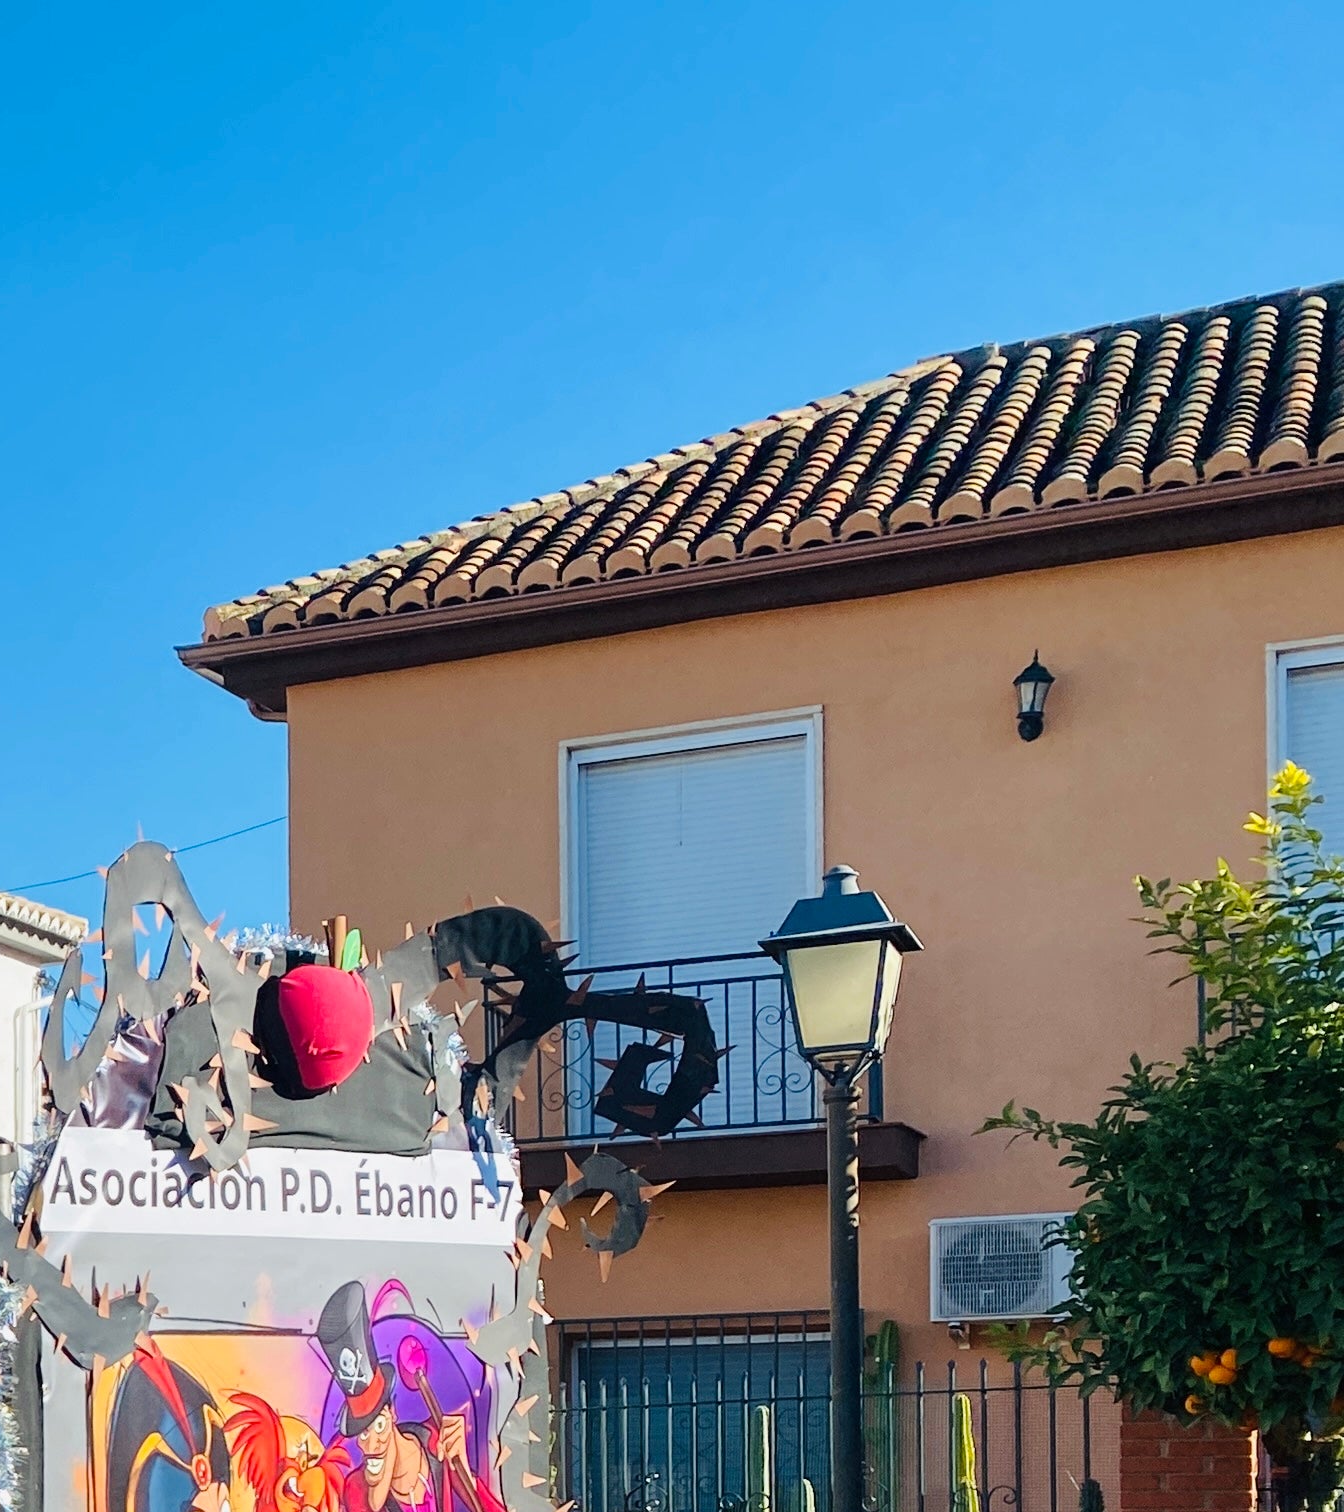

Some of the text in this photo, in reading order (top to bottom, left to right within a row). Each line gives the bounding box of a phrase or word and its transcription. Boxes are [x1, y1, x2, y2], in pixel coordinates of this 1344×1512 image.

[280, 1167, 342, 1215] P.D.
[355, 1158, 458, 1220] Ébano
[471, 1178, 514, 1222] F-7
